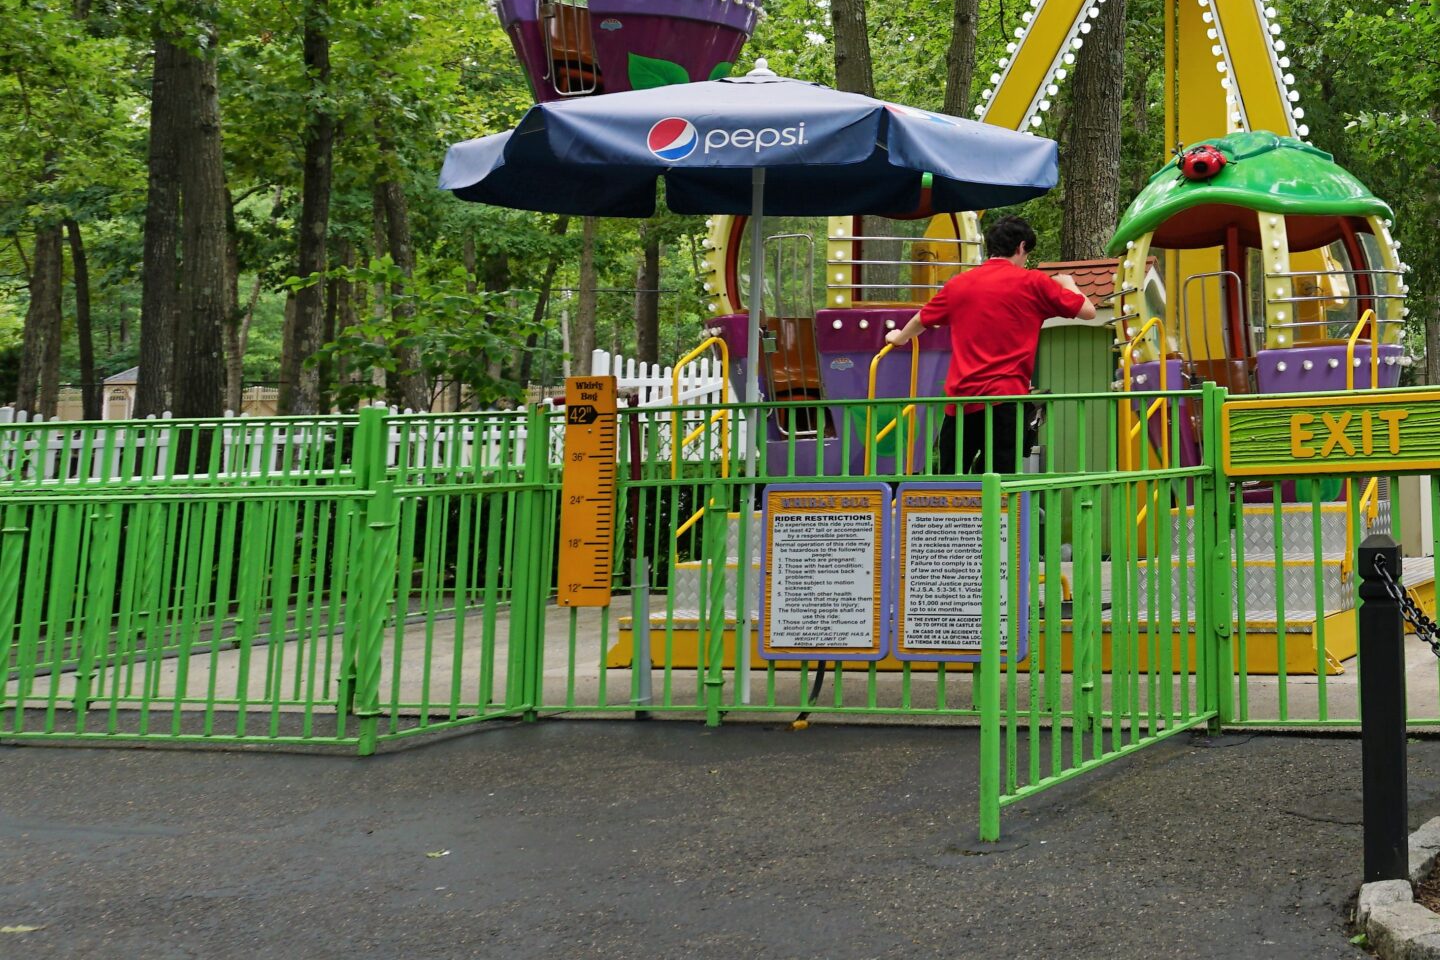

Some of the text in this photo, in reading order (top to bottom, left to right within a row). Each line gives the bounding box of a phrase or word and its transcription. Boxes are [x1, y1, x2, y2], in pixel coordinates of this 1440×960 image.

[575, 381, 604, 390] Whirly
[569, 406, 592, 423] 42"
[1290, 409, 1408, 458] EXIT
